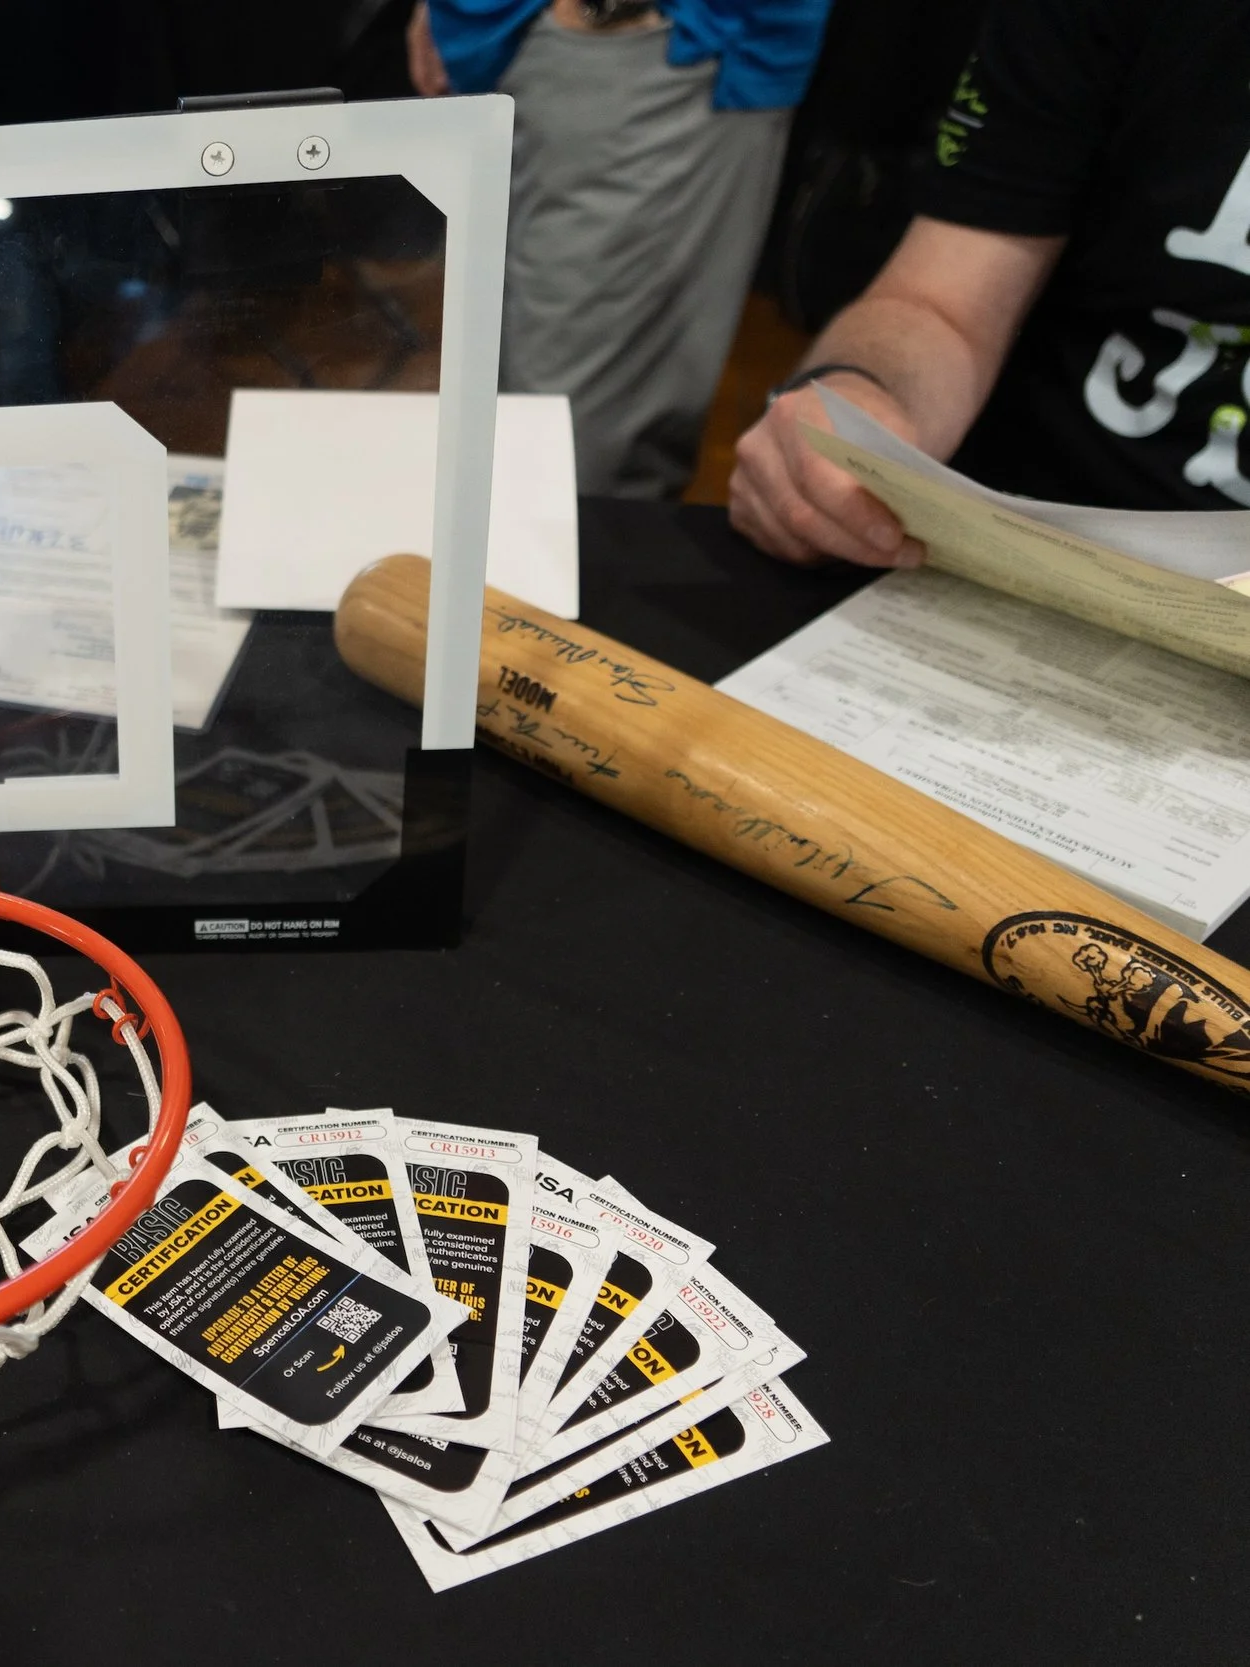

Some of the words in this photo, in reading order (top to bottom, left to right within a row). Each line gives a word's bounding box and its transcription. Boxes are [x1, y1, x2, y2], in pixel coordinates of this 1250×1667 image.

[499, 666, 557, 714] MODEL
[209, 922, 246, 931] CAUTION
[250, 921, 263, 930] DO
[265, 921, 282, 930] NOT
[283, 920, 308, 930] HANG
[309, 920, 323, 929] ON
[324, 919, 340, 929] RIM
[1053, 922, 1078, 936] NC
[1201, 985, 1244, 1021] BULLS
[277, 1123, 340, 1133] CERTIFICATION
[341, 1120, 380, 1128] NUMBER:
[299, 1130, 363, 1144] CR15912
[411, 1130, 475, 1143] CERTIFICATION
[477, 1138, 518, 1148] NUMBER:
[430, 1141, 496, 1158] CR15913
[110, 1197, 195, 1266] BASIC
[341, 1212, 388, 1225] examined
[557, 1214, 599, 1233] NUMBER:
[589, 1193, 651, 1230] CERTIFICATION
[651, 1226, 691, 1251] NUMBER:
[117, 1198, 233, 1295] CERTIFICATION
[424, 1228, 445, 1240] fully
[446, 1232, 495, 1246] examined
[432, 1239, 488, 1253] considered
[144, 1299, 163, 1316] This
[161, 1287, 179, 1303] item
[176, 1275, 192, 1290] has
[189, 1259, 210, 1277] been
[207, 1245, 226, 1264] fully
[223, 1218, 257, 1248] examined
[282, 1255, 299, 1269] OF
[426, 1247, 498, 1263] authenticators
[451, 1260, 495, 1274] genuine.
[157, 1305, 170, 1318] by
[168, 1293, 187, 1311] JSA,
[184, 1280, 201, 1296] and
[198, 1274, 207, 1284] it
[205, 1268, 213, 1278] is
[209, 1258, 225, 1273] the
[222, 1227, 262, 1262] considered
[159, 1303, 189, 1331] opinion
[186, 1295, 197, 1307] of
[194, 1285, 208, 1300] our
[207, 1267, 232, 1290] expert
[229, 1227, 277, 1271] authenticators
[169, 1320, 188, 1337] that
[185, 1309, 199, 1324] the
[197, 1276, 240, 1314] signature(s)
[237, 1259, 258, 1280] is/are
[255, 1235, 287, 1263] genuine.
[256, 1265, 289, 1293] LETTER
[460, 1281, 475, 1294] OF
[207, 1303, 266, 1357] AUTHENTICITY
[261, 1297, 275, 1308] &
[268, 1272, 300, 1301] VERIFY
[294, 1256, 319, 1276] THIS
[238, 1295, 256, 1308] TO
[250, 1289, 263, 1300] A
[679, 1285, 727, 1331] R15922
[201, 1305, 245, 1342] UPGRADE
[220, 1307, 284, 1364] CERTIFICATION
[276, 1297, 294, 1312] BY
[288, 1265, 330, 1301] VISITING:
[253, 1288, 330, 1358] SpenceLOA.com
[719, 1305, 754, 1339] NUMBER:
[283, 1366, 296, 1378] Or
[293, 1350, 315, 1370] Scan
[326, 1371, 356, 1399] Follow
[354, 1360, 367, 1373] us
[364, 1352, 376, 1363] at
[372, 1325, 404, 1356] @jsaloa
[770, 1391, 804, 1433] NUMBER:
[357, 1432, 372, 1443] us
[373, 1440, 387, 1450] at
[387, 1445, 432, 1471] @jsaloa
